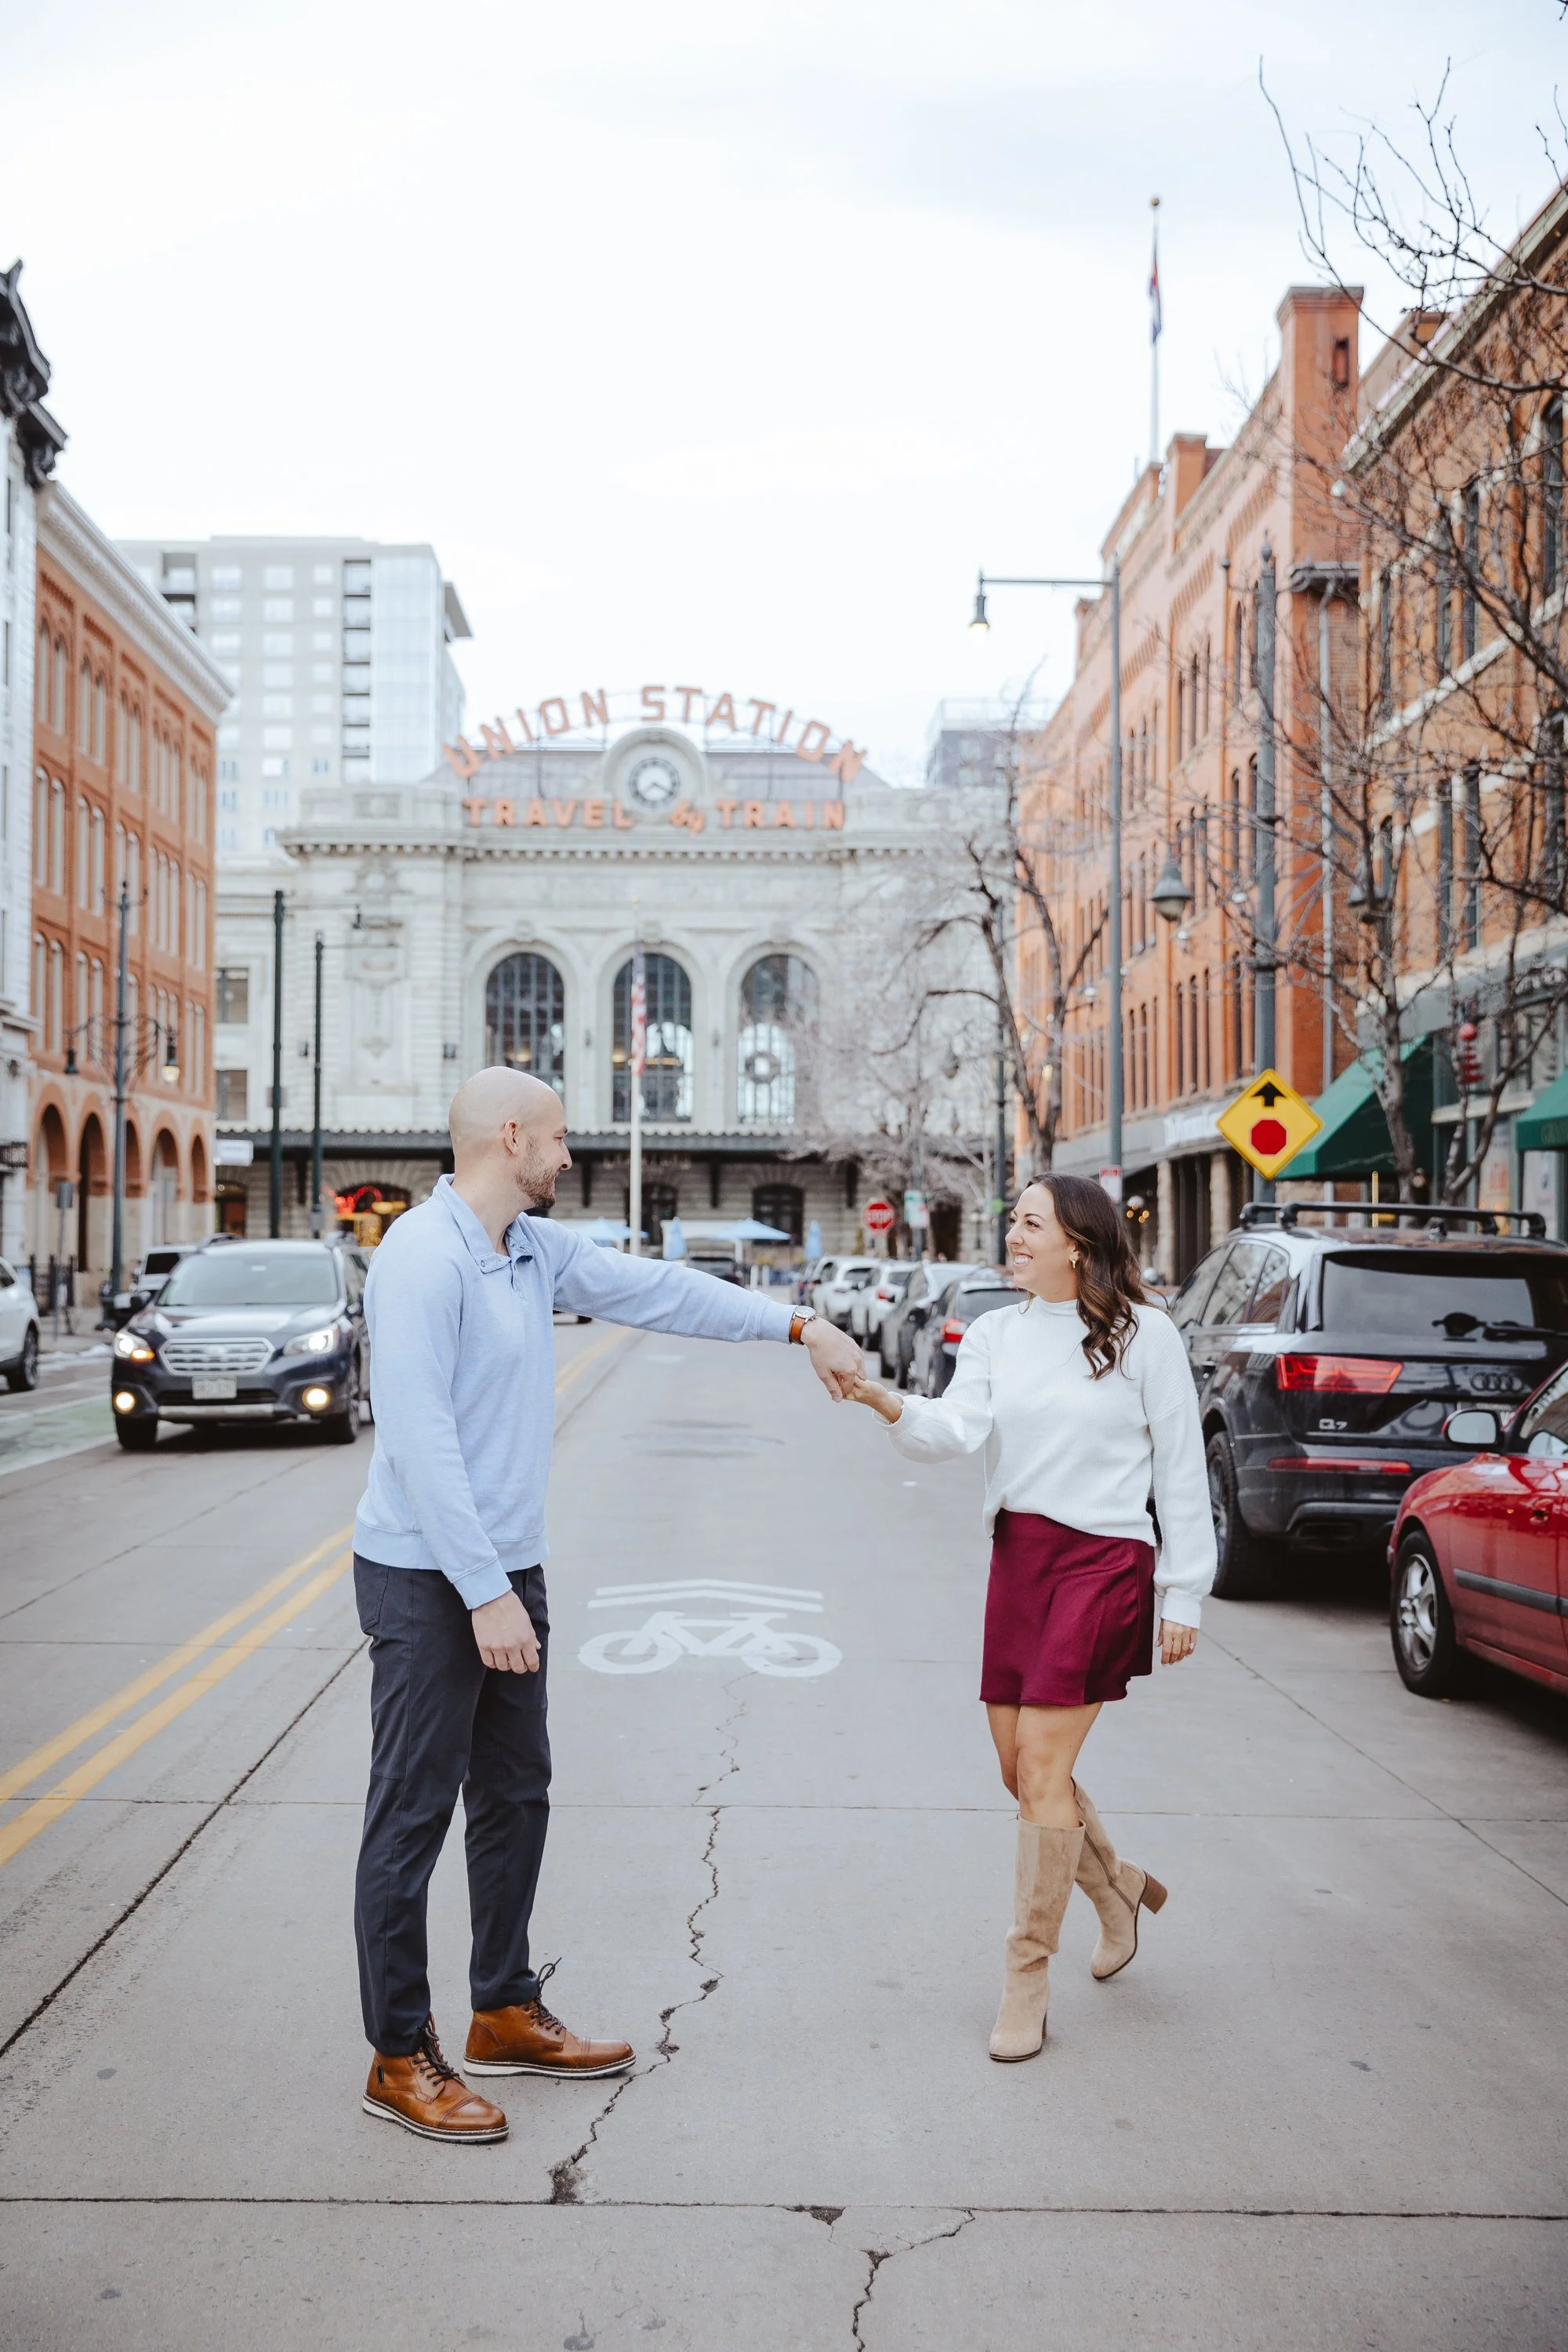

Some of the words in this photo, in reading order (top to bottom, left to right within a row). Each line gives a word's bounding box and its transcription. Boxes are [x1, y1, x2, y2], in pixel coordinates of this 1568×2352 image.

[442, 688, 609, 779] UNION
[641, 685, 868, 783] STATION
[462, 798, 633, 829] TRAVEL
[717, 800, 845, 831] TRAIN
[865, 1209, 892, 1223] STOP
[1319, 1417, 1348, 1431] Q7
